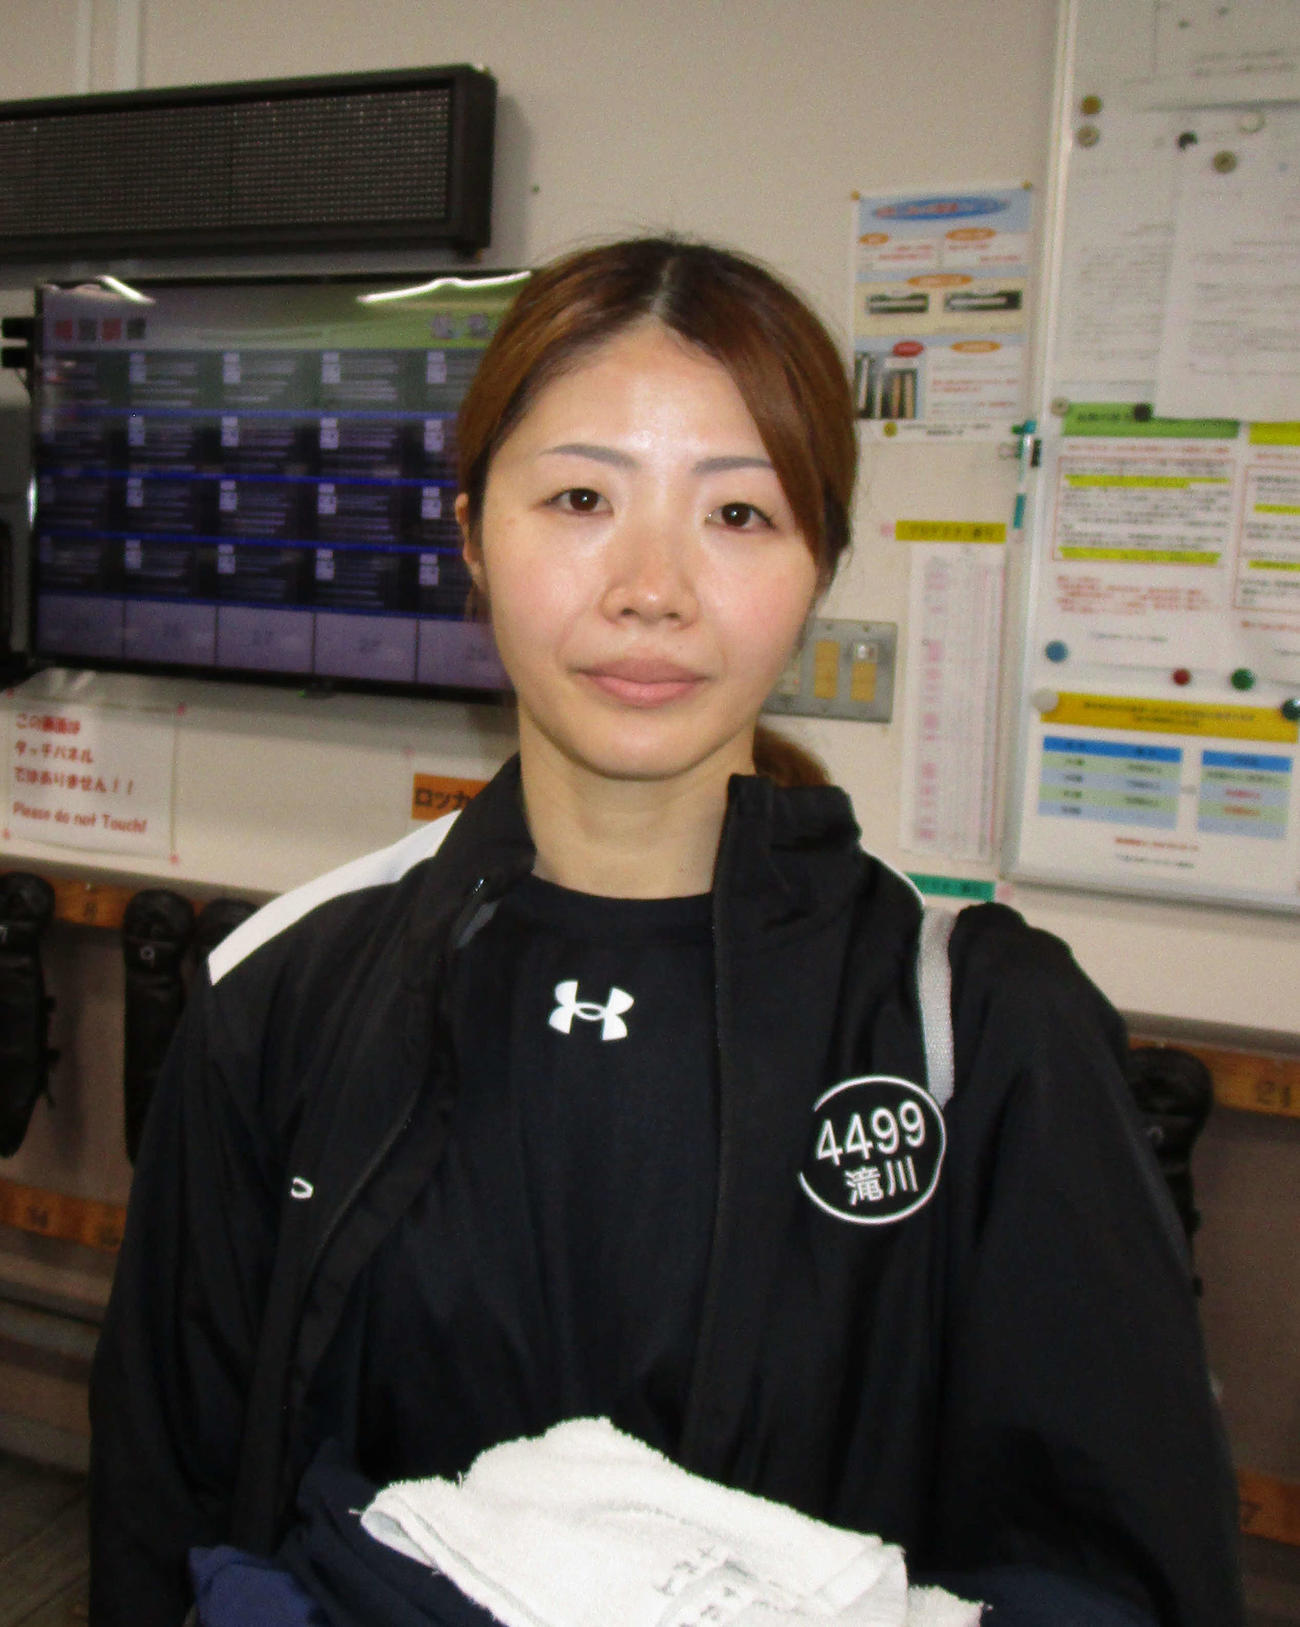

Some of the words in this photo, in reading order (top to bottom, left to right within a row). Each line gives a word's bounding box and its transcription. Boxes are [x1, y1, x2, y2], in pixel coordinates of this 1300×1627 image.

[16, 740, 93, 764] タッチパネル
[13, 801, 51, 821] Please
[54, 810, 70, 824] do
[74, 813, 97, 826] not
[816, 1100, 926, 1167] 4499
[844, 1155, 919, 1207] 滝川
